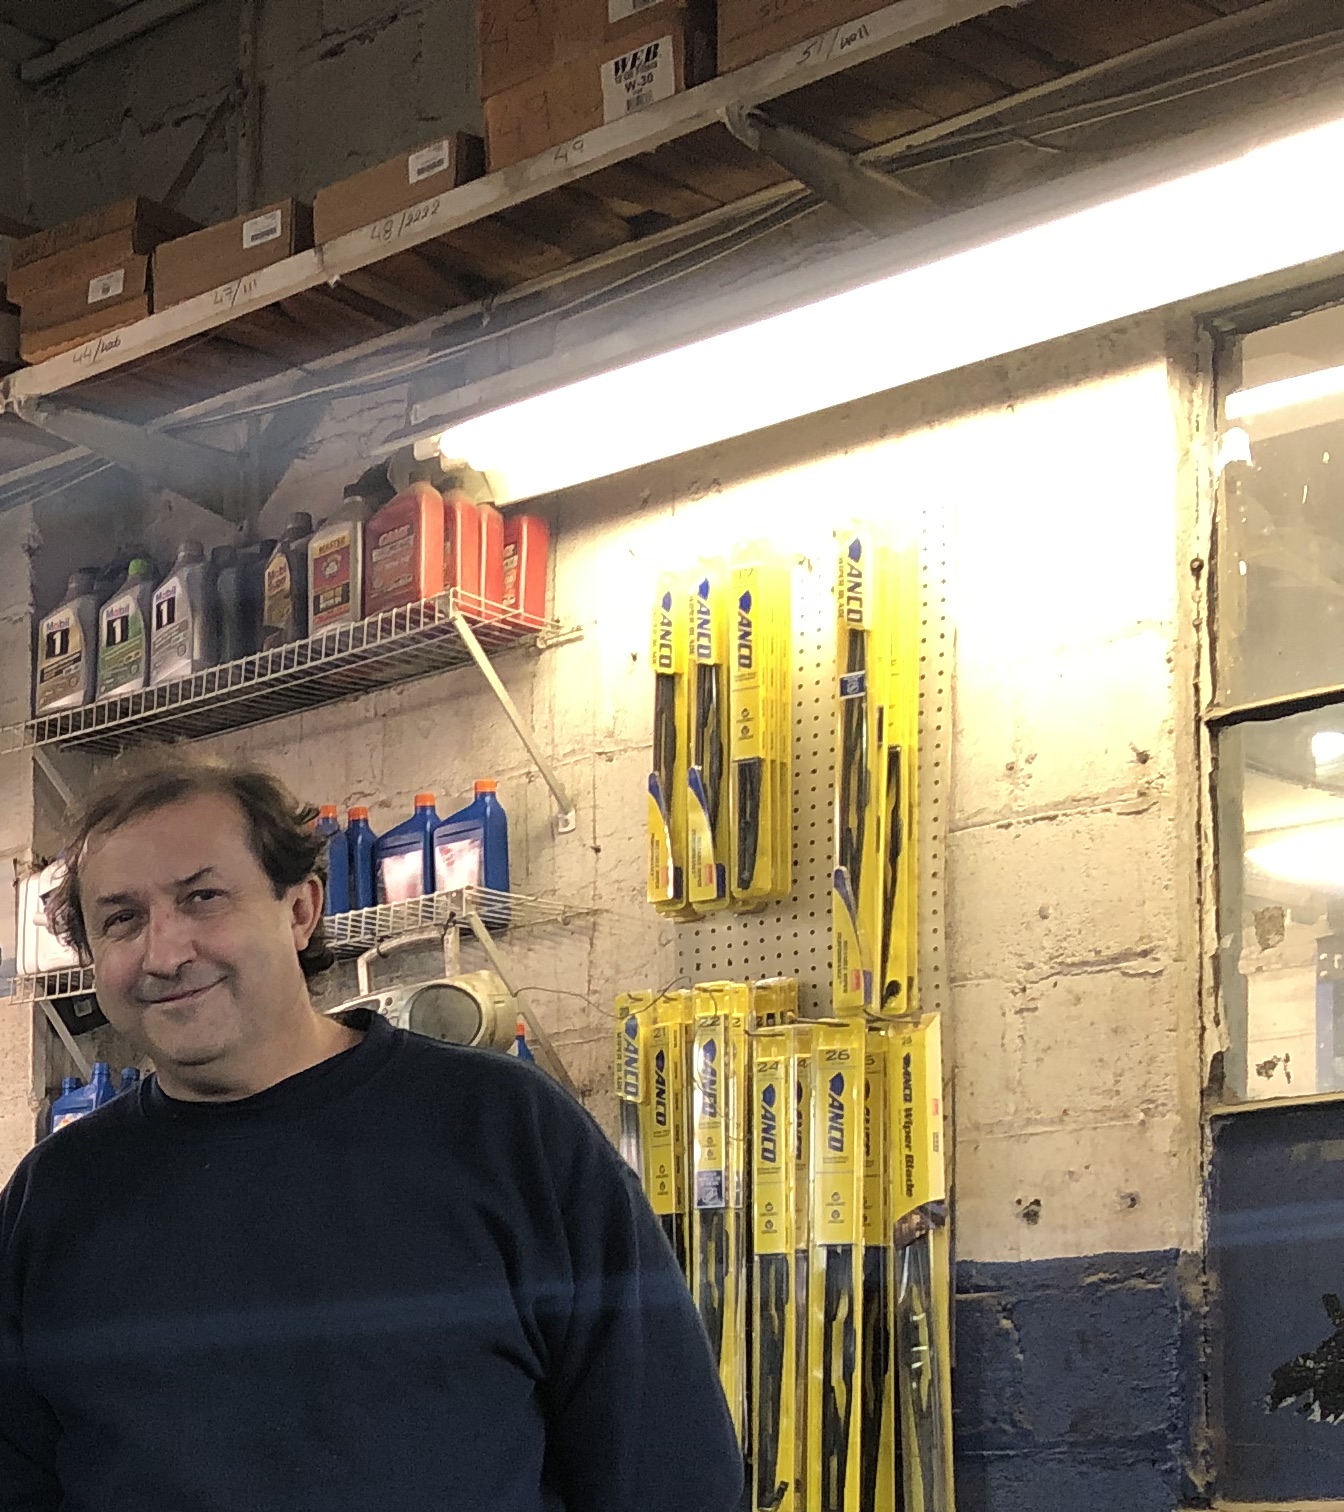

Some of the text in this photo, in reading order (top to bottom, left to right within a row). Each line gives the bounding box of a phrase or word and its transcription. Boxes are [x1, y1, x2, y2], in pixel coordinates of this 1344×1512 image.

[107, 604, 130, 620] Mobil
[156, 586, 176, 603] Mobil
[847, 562, 863, 623] ANCO
[46, 616, 70, 632] Mobil
[659, 613, 673, 669] ANCO
[697, 600, 712, 660] ANCO
[738, 610, 752, 669] ANCO
[653, 1028, 666, 1039] 21
[699, 1017, 721, 1027] 22
[624, 1039, 639, 1097] ANCO
[757, 1061, 780, 1073] 24
[825, 1050, 850, 1062] 26
[655, 1070, 667, 1127] ANCO
[702, 1062, 717, 1118] ANCO
[761, 1105, 777, 1163] ANCO
[828, 1093, 845, 1152] ANCO
[903, 1107, 914, 1152] Wiper
[905, 1154, 915, 1198] Blade
